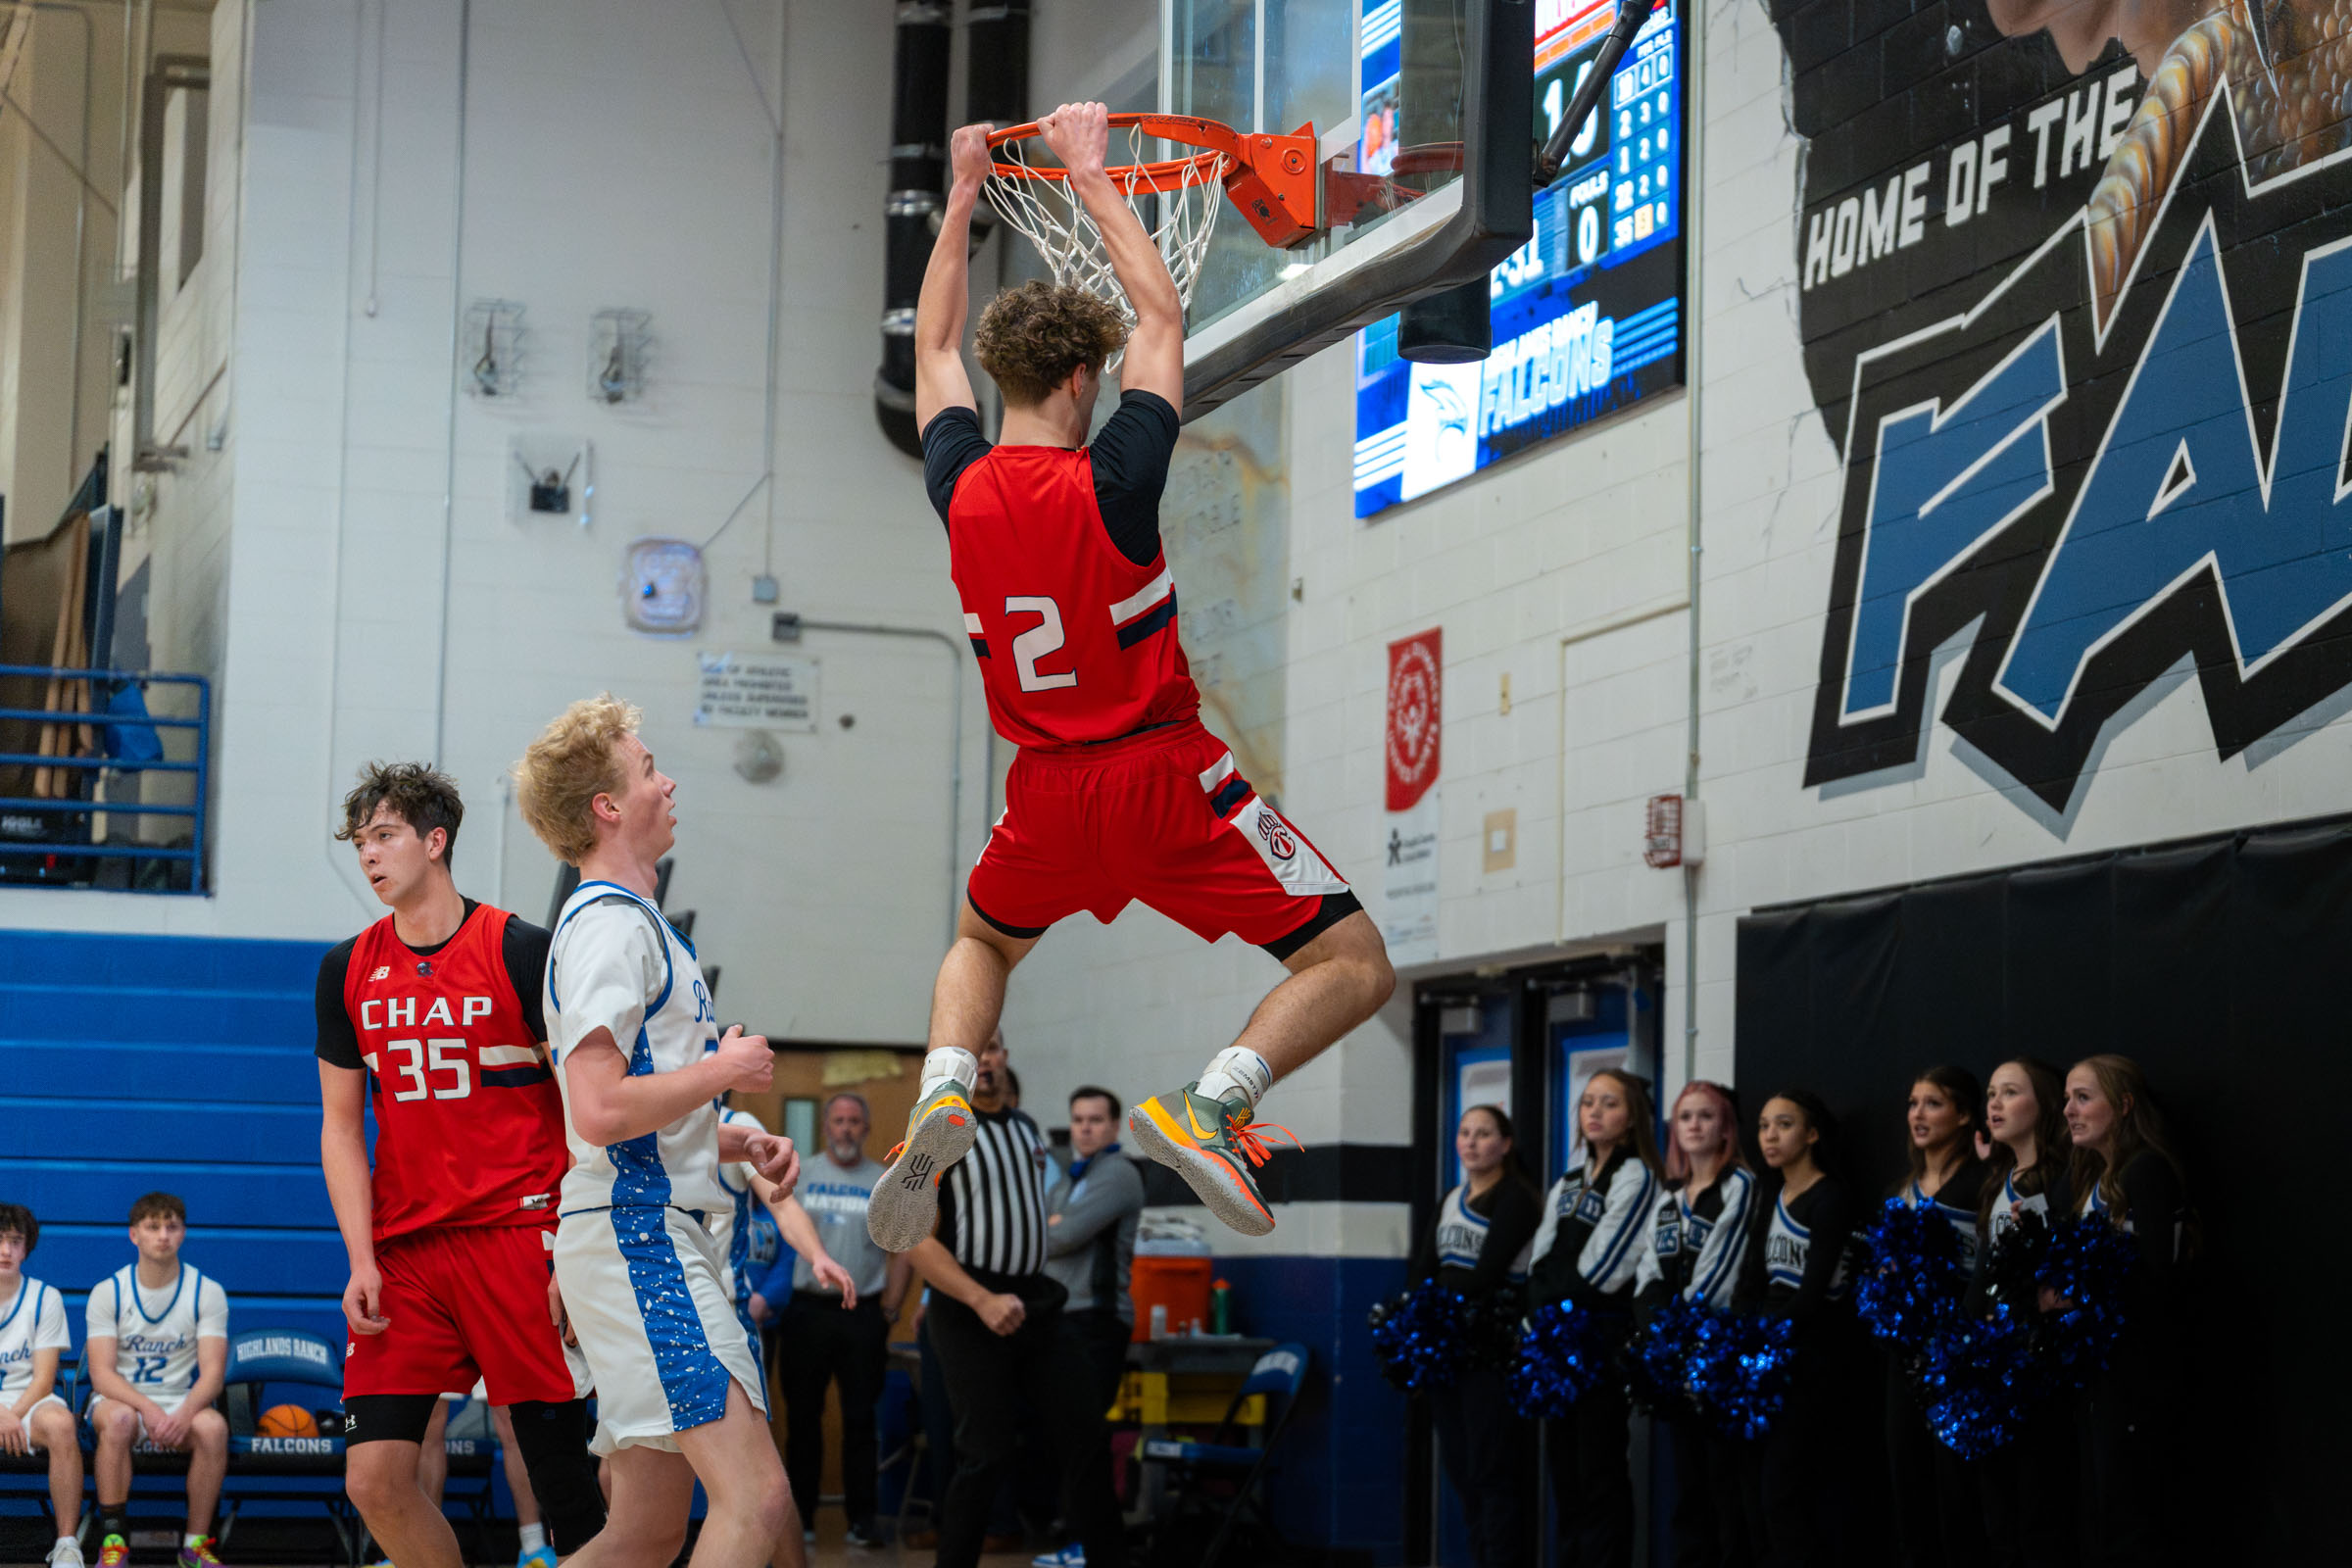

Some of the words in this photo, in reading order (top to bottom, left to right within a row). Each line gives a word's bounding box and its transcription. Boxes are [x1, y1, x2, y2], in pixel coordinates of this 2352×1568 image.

[1803, 162, 1930, 291] HOME
[1945, 125, 2011, 227] OF
[2028, 65, 2137, 188] THE
[1578, 205, 1599, 267] 0
[1478, 317, 1614, 438] FALCONS
[1004, 595, 1078, 693] 2
[361, 996, 492, 1031] CHAP
[387, 1037, 471, 1102] 35
[124, 1333, 186, 1352] Ranch
[236, 1338, 291, 1362] HIGHLANDS
[294, 1338, 327, 1364] RANCH
[133, 1355, 169, 1383] 12
[251, 1437, 333, 1454] FALCONS
